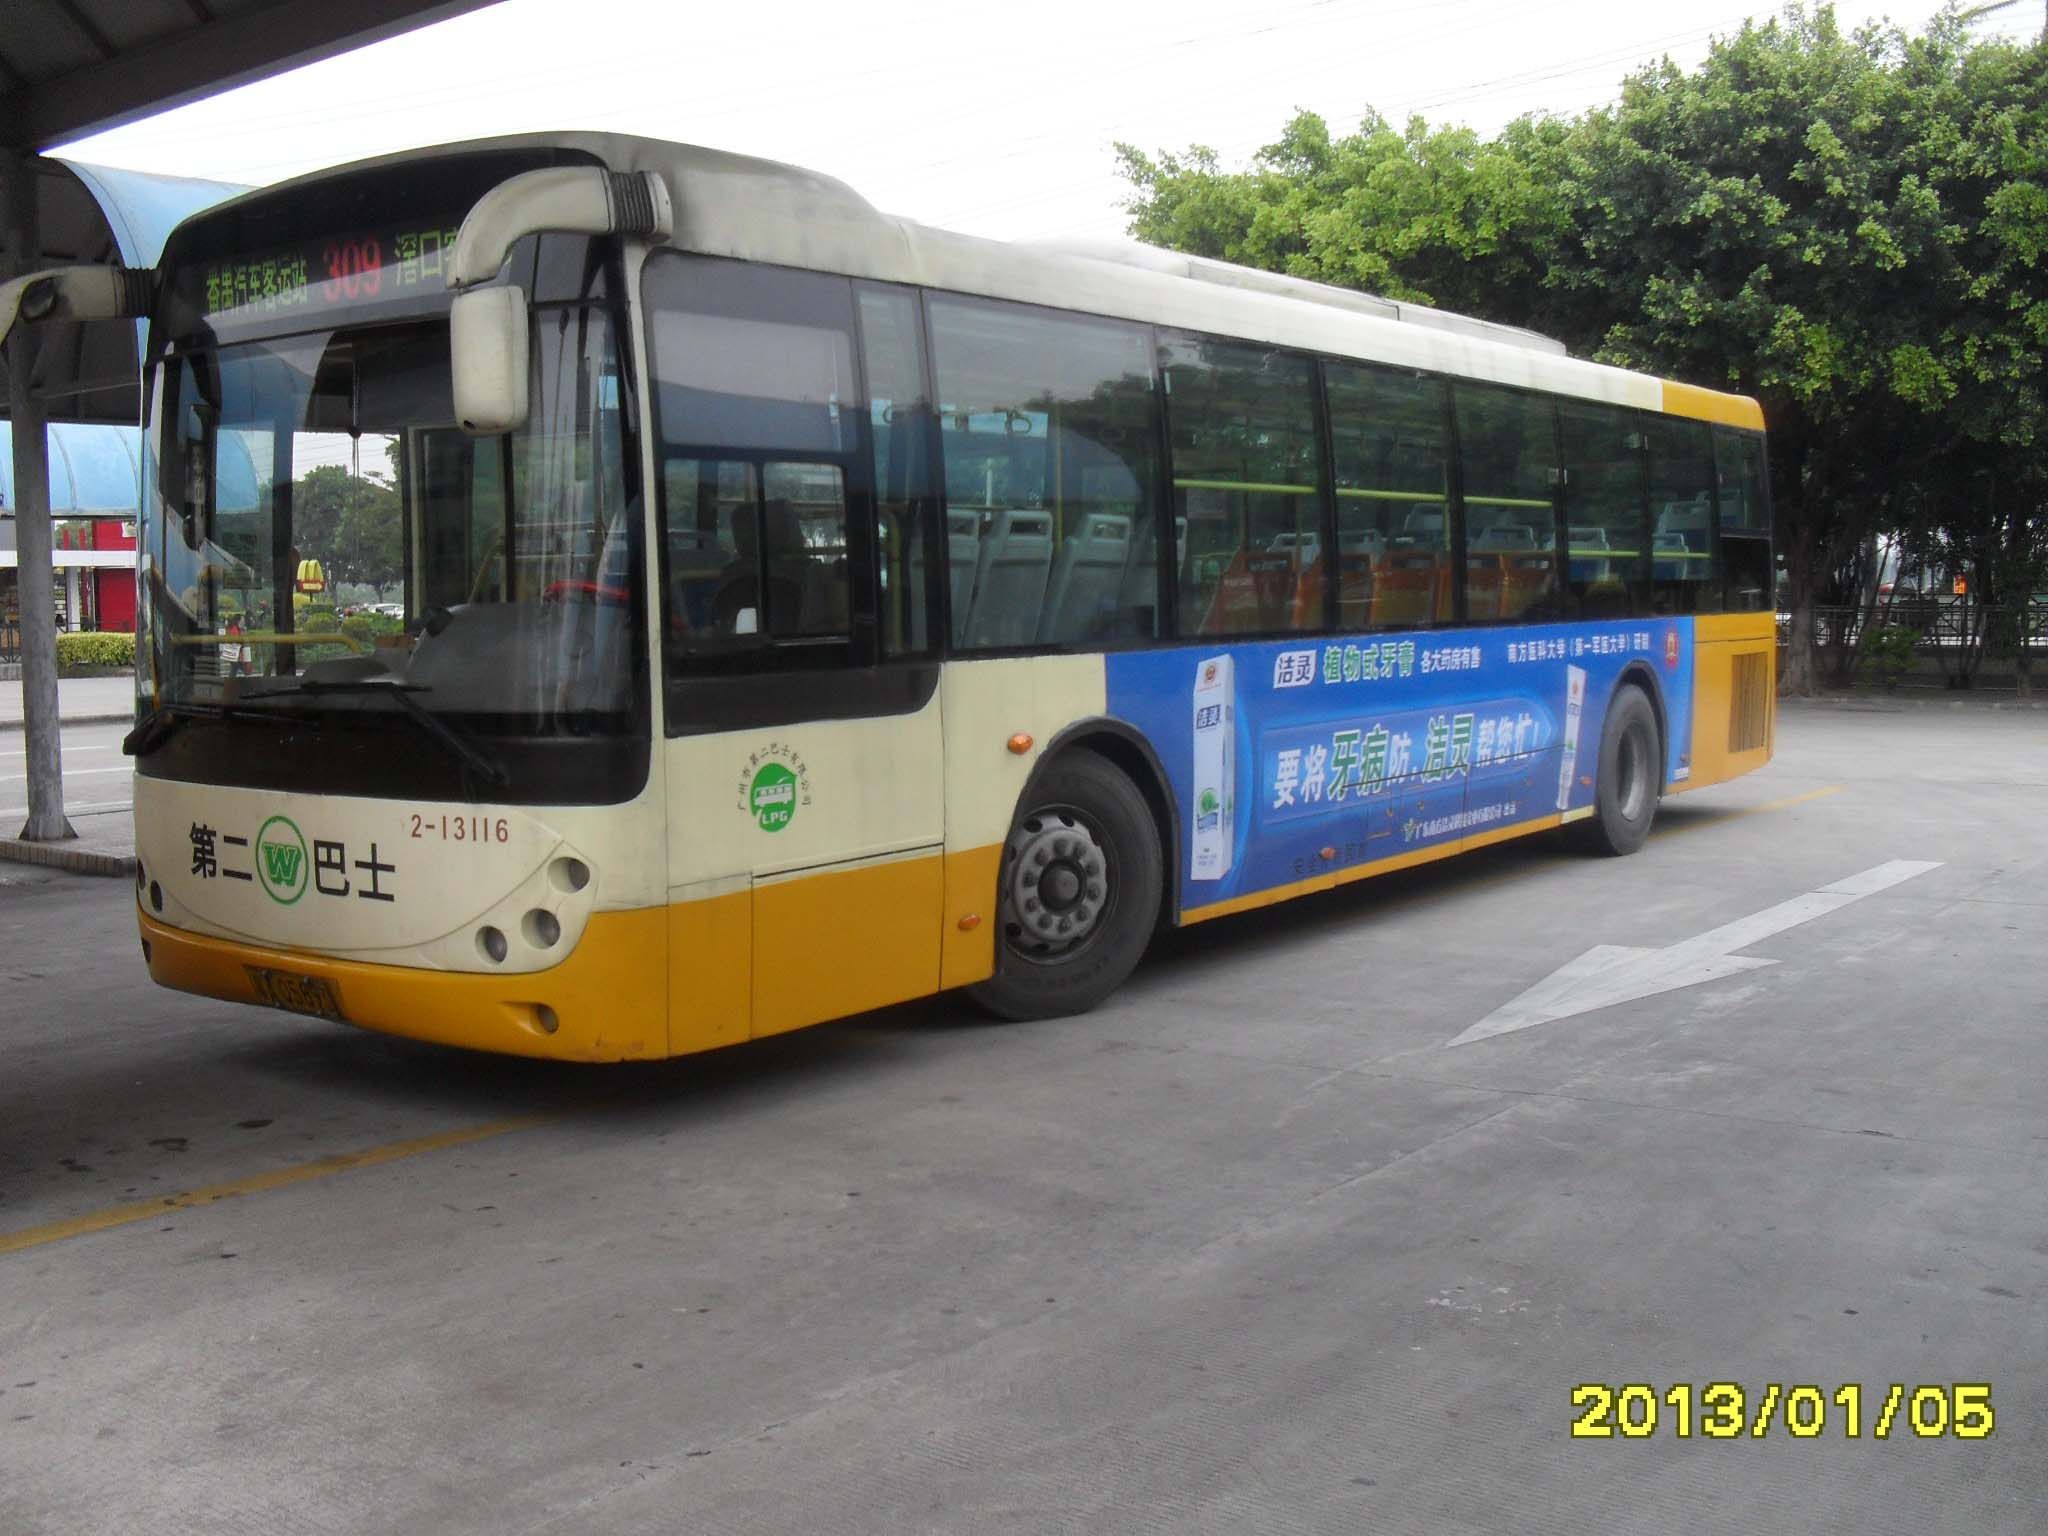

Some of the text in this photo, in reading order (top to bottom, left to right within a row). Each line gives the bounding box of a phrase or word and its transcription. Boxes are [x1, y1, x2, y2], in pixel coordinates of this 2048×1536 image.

[323, 240, 382, 303] 309
[1277, 655, 1313, 683] 洁灵
[411, 813, 509, 843] 2-13116
[762, 810, 788, 825] LPG
[189, 822, 253, 881] 第二
[313, 839, 396, 902] 巴士
